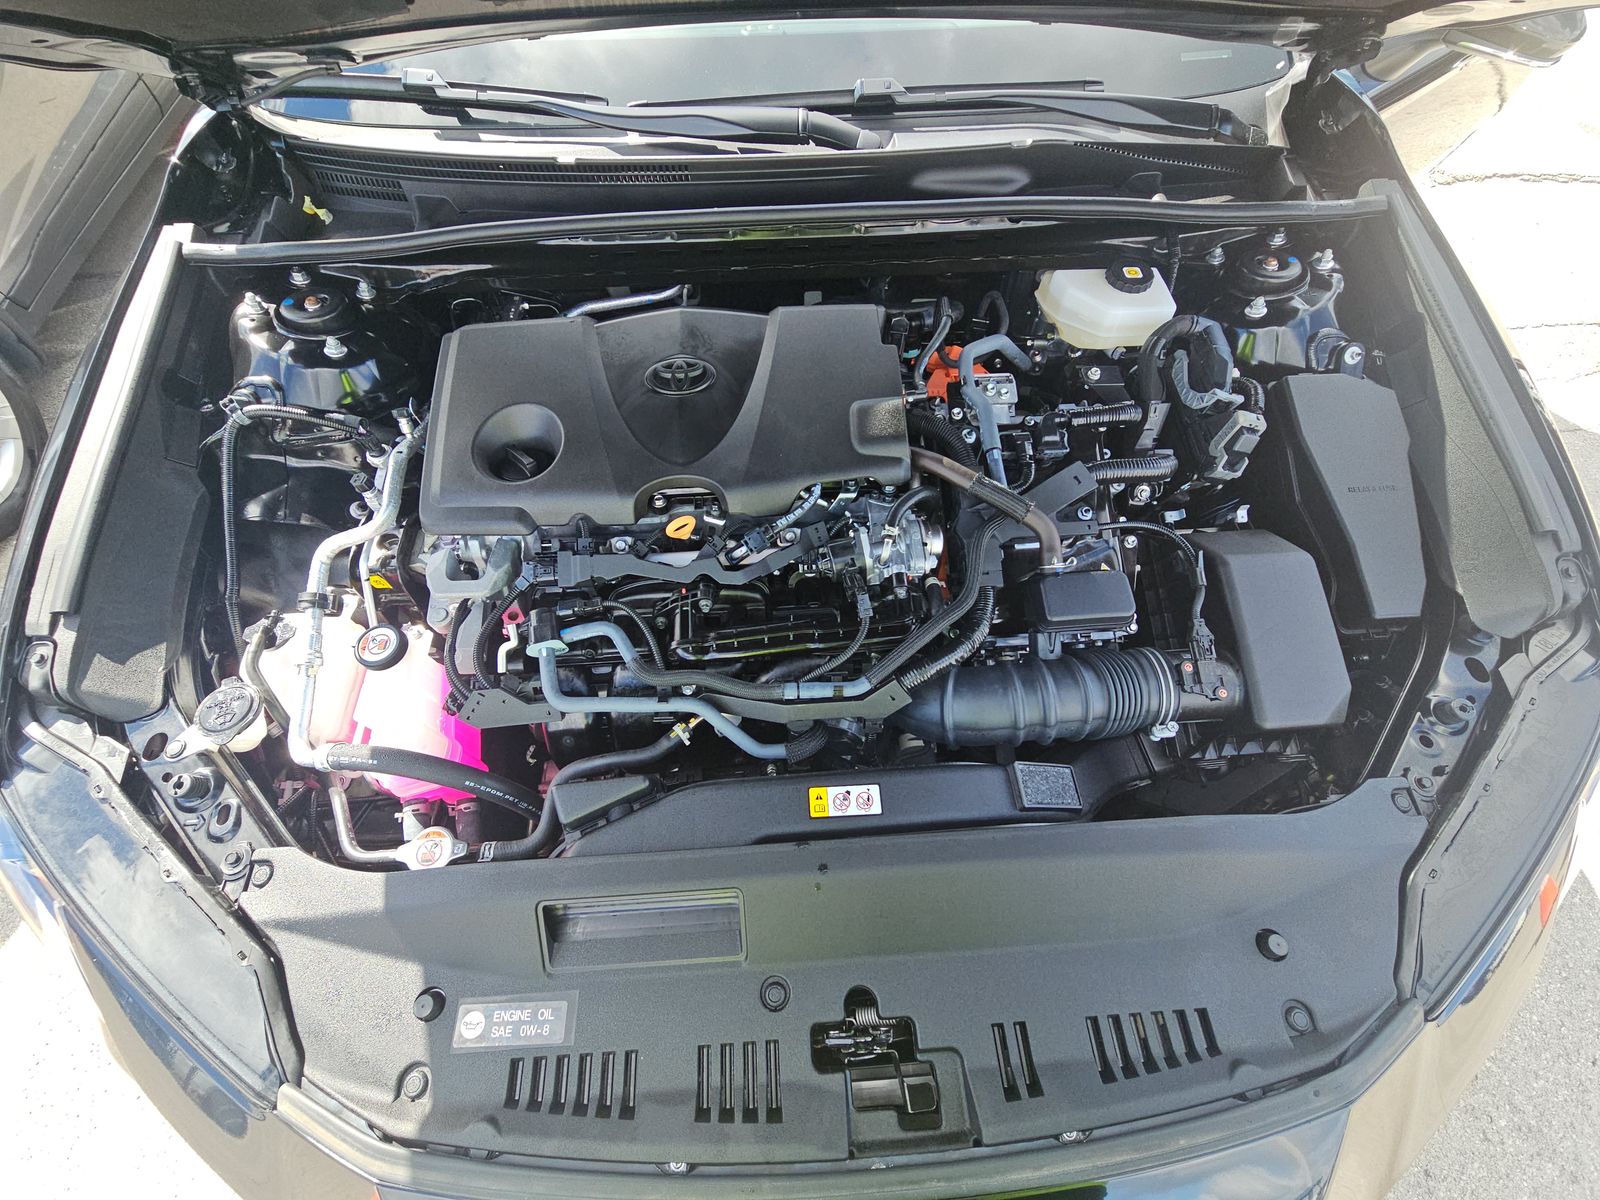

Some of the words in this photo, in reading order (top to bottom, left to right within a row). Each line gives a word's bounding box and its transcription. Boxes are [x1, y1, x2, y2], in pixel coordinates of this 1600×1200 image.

[493, 1009, 531, 1022] ENGINE
[538, 1008, 555, 1020] OIL
[491, 1025, 512, 1038] SAE
[520, 1024, 550, 1037] 0W-8
